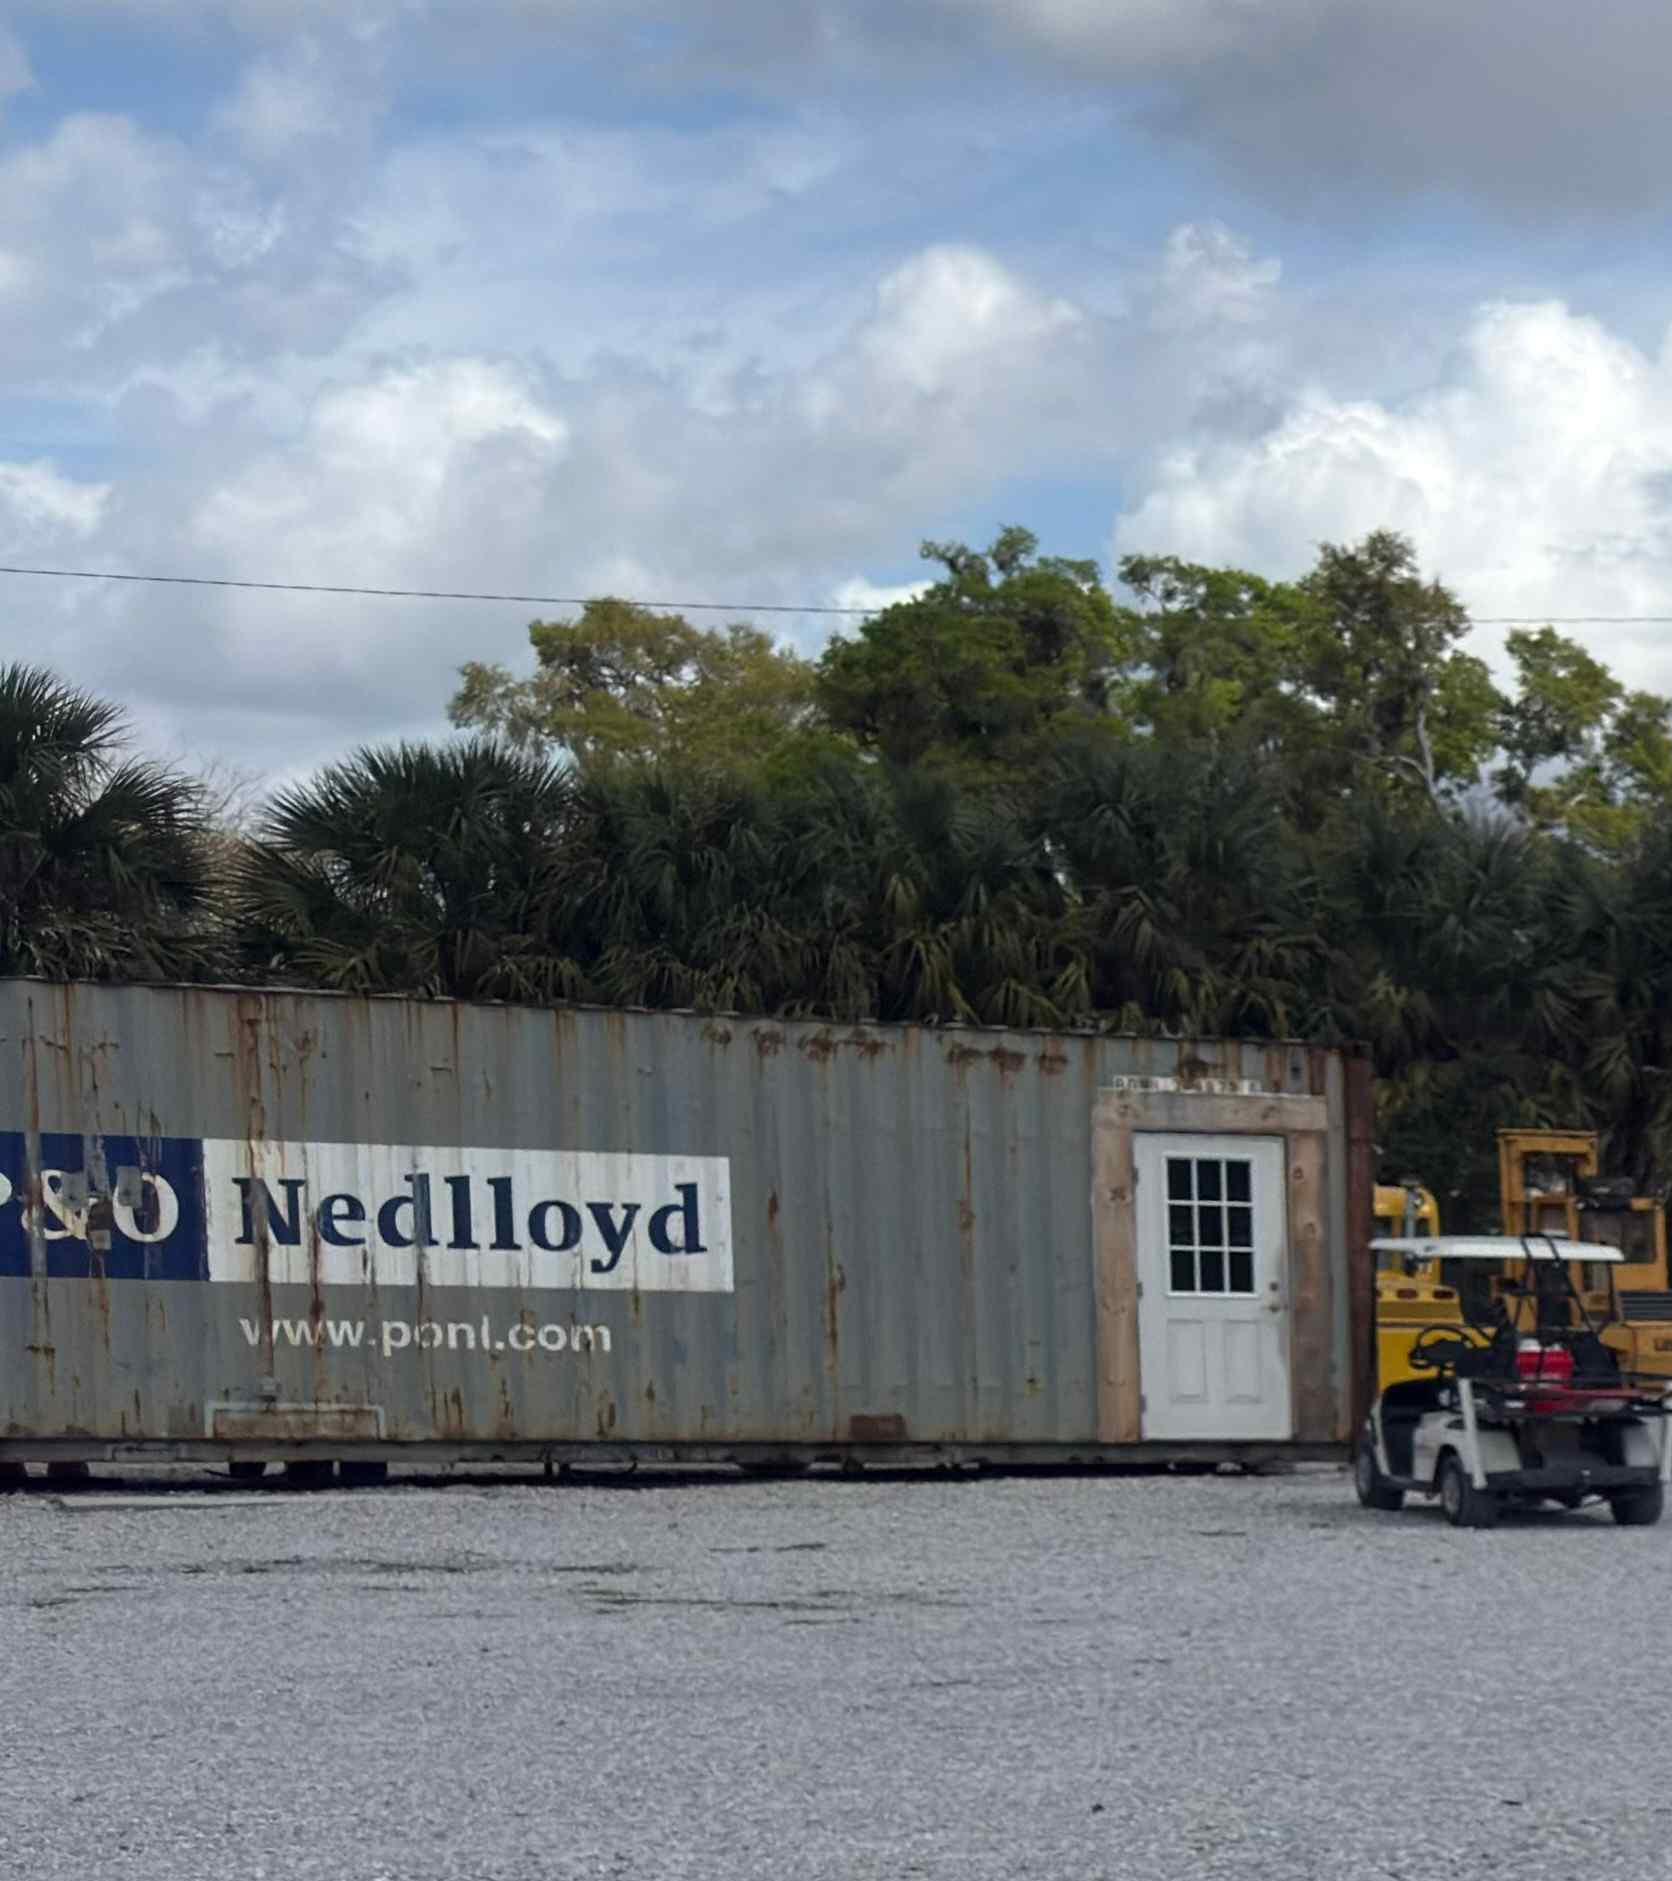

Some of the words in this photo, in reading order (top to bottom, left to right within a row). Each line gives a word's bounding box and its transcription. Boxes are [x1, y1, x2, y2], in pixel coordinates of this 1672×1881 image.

[0, 1168, 180, 1243] &O
[232, 1172, 708, 1274] Nedlloyd
[239, 1315, 612, 1357] www.ponl.com
